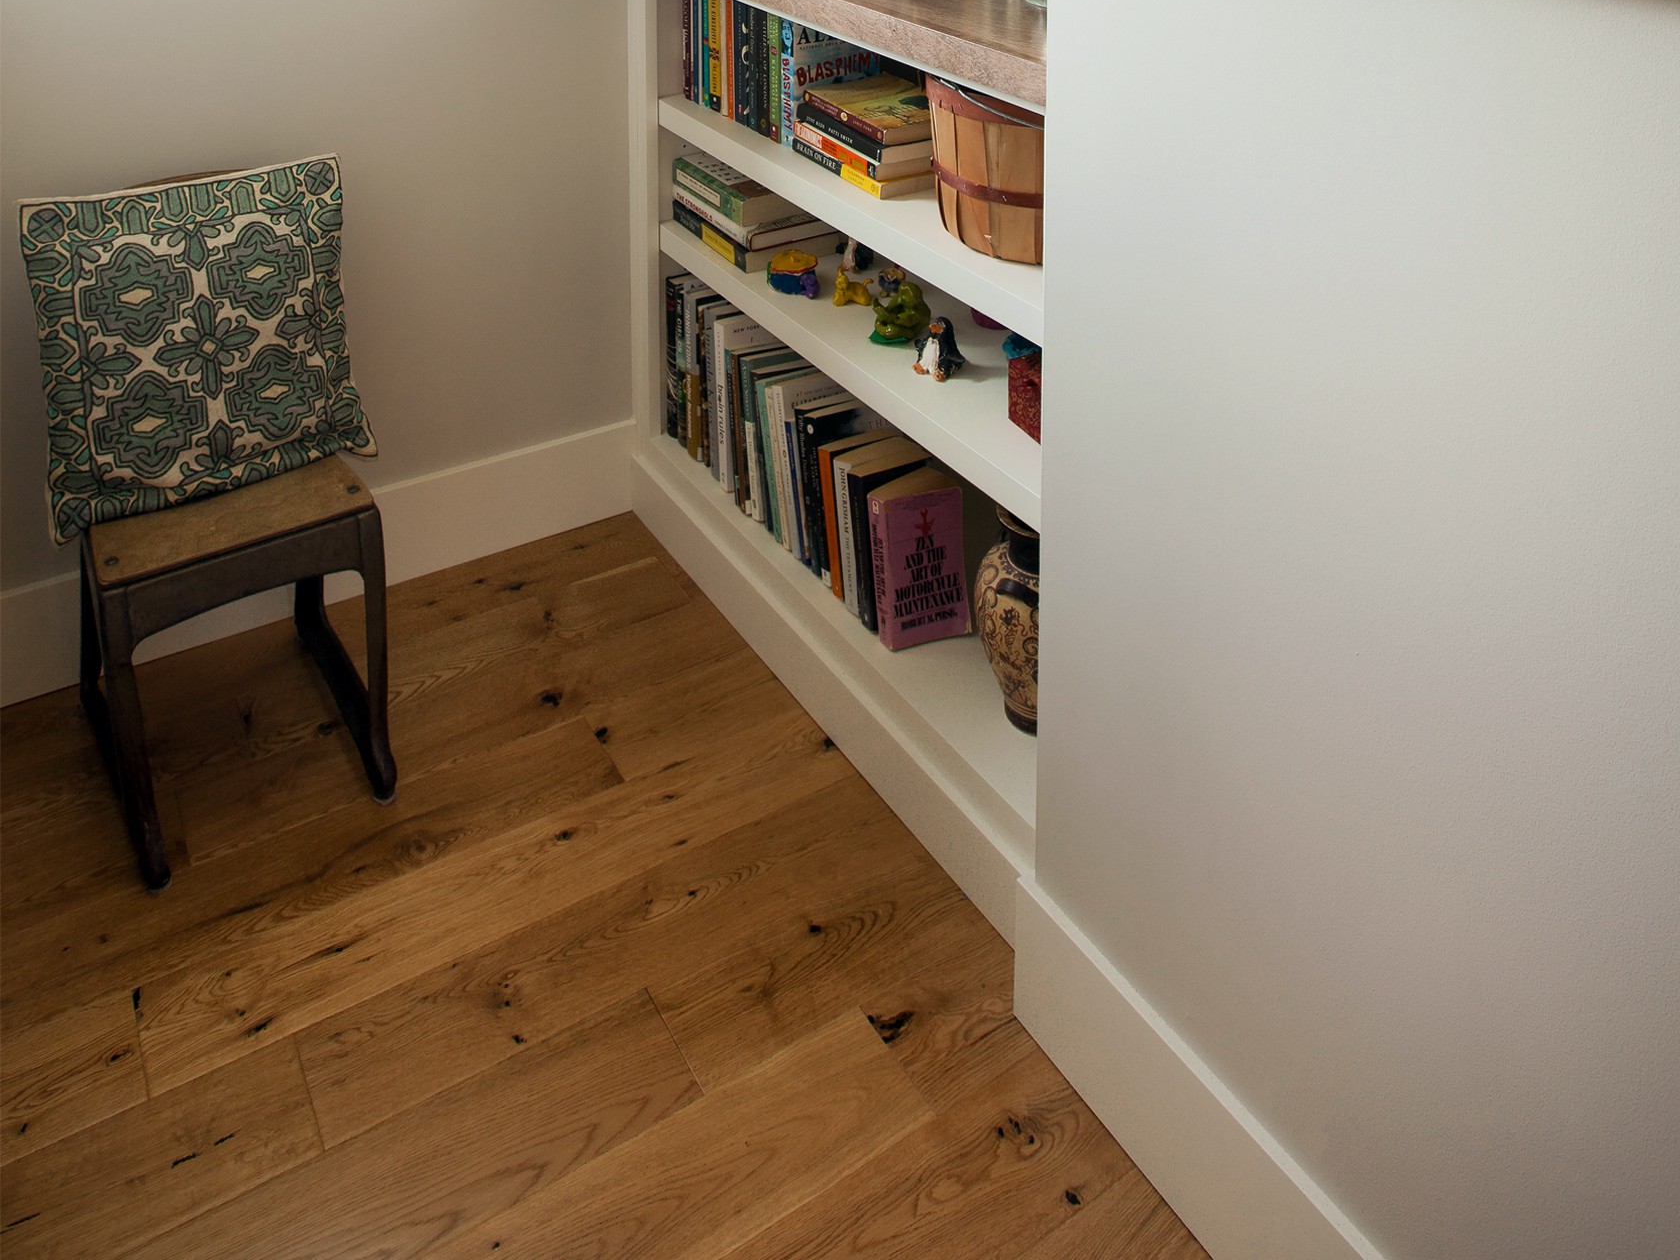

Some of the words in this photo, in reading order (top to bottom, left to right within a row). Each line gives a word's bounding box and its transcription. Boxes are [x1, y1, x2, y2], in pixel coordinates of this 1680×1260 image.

[796, 52, 880, 87] BLASPHEMY
[781, 58, 792, 131] BLASPHEMY
[815, 120, 825, 130] KIDS
[828, 127, 840, 137] PATTI
[840, 133, 854, 144] SMITH
[796, 142, 814, 157] BRAIN
[813, 150, 823, 162] ON
[823, 156, 837, 170] FIRE
[676, 193, 684, 202] THE
[684, 198, 713, 222] STRONGHOLD
[676, 340, 682, 354] ON
[797, 414, 805, 432] Fifty
[799, 433, 807, 458] Shades
[839, 467, 847, 492] JOHN
[841, 493, 850, 534] GRISHAM
[915, 534, 935, 552] ZEN
[904, 553, 924, 570] AND
[927, 546, 947, 563] THE
[910, 566, 929, 584] ART
[930, 561, 944, 578] OF
[894, 572, 961, 603] MOTORCYCLE
[893, 587, 964, 619] MAINTENANCE
[901, 616, 926, 631] ROBERT
